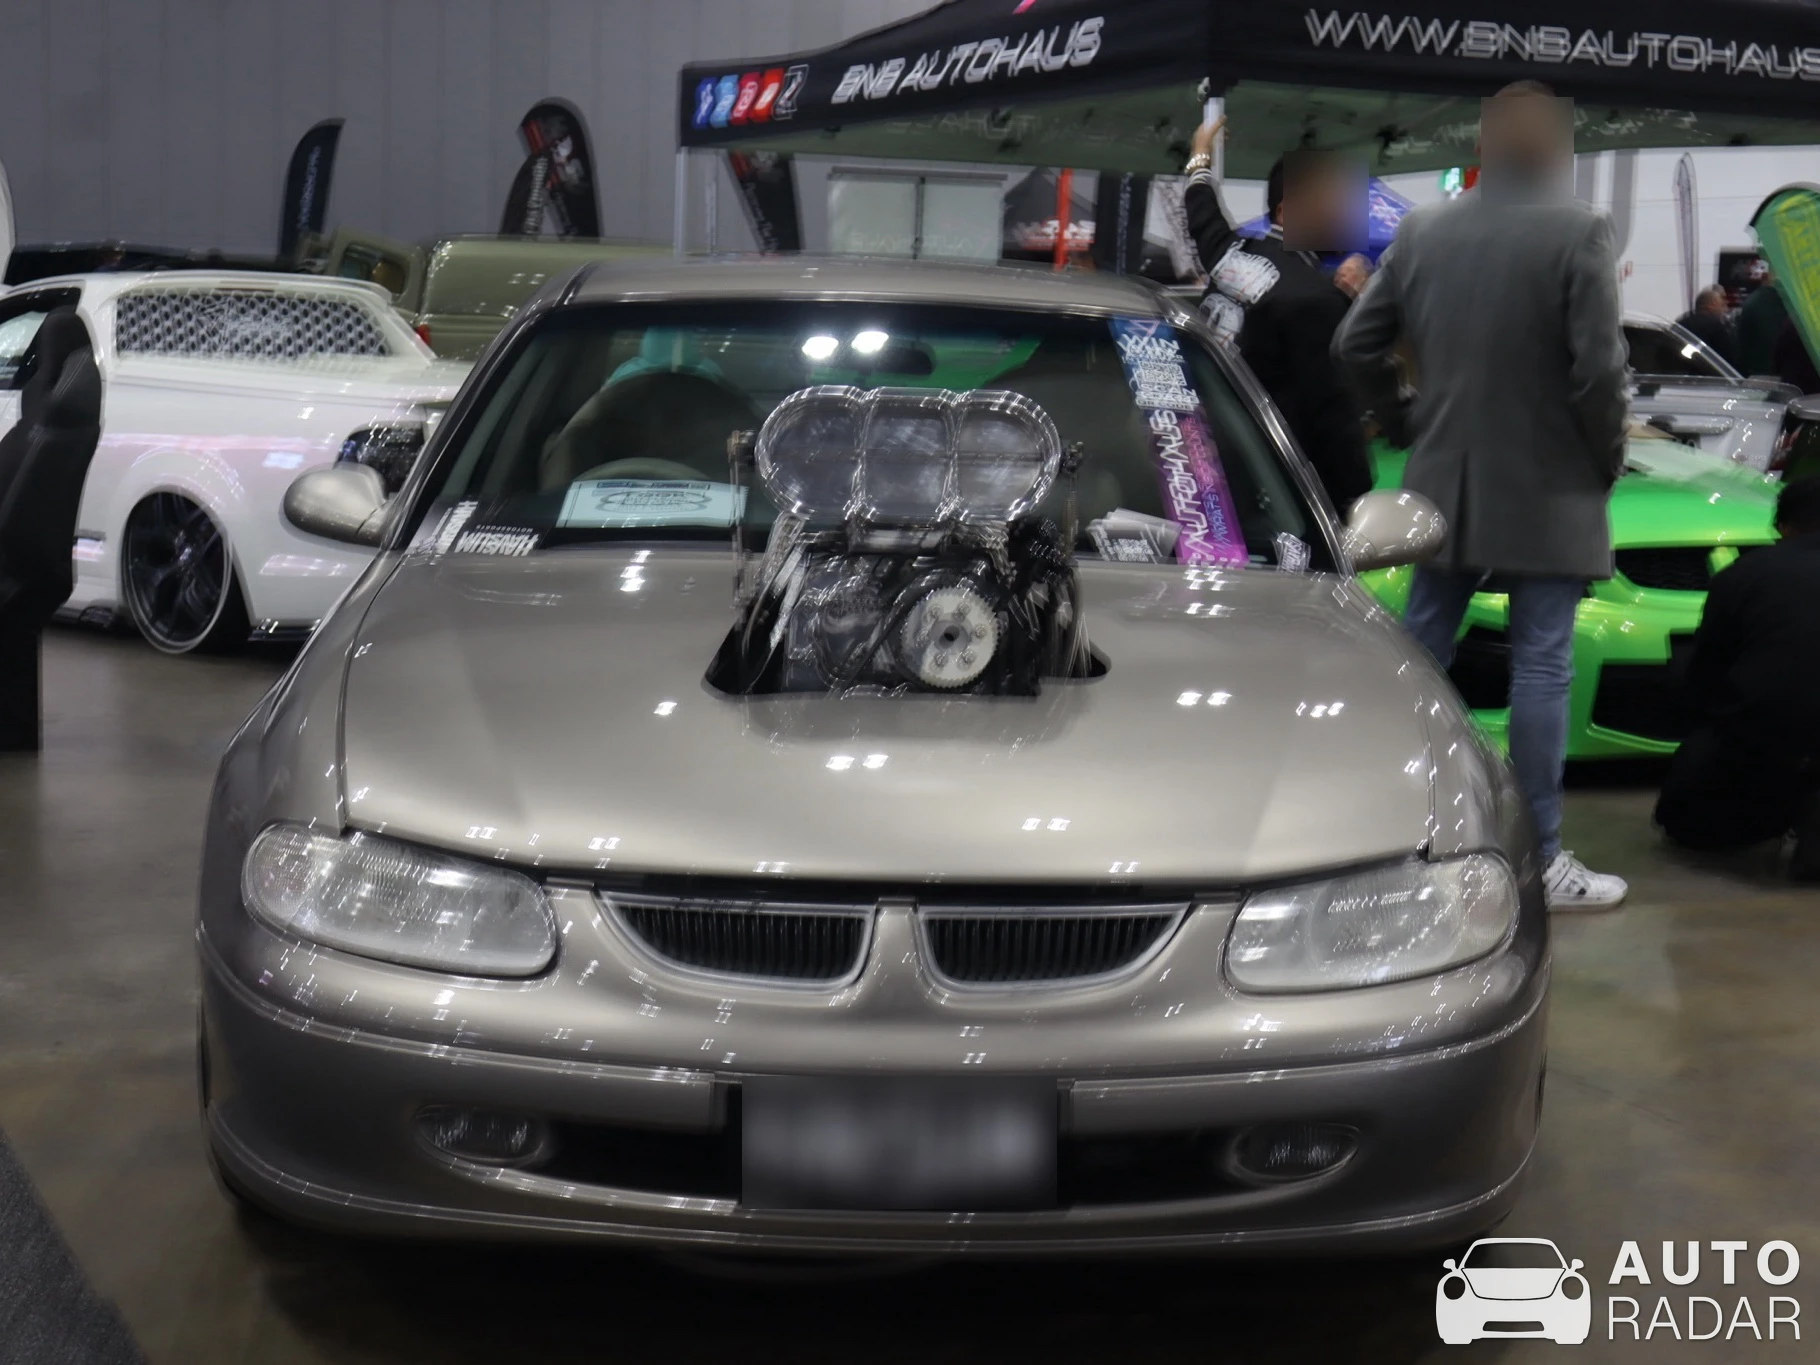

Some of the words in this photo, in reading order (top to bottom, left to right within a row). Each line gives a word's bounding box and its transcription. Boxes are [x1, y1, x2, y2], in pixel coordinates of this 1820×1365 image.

[830, 55, 907, 105] BNB
[898, 16, 1105, 91] AUTOHAUS
[1149, 409, 1214, 555] AUTOHAUS
